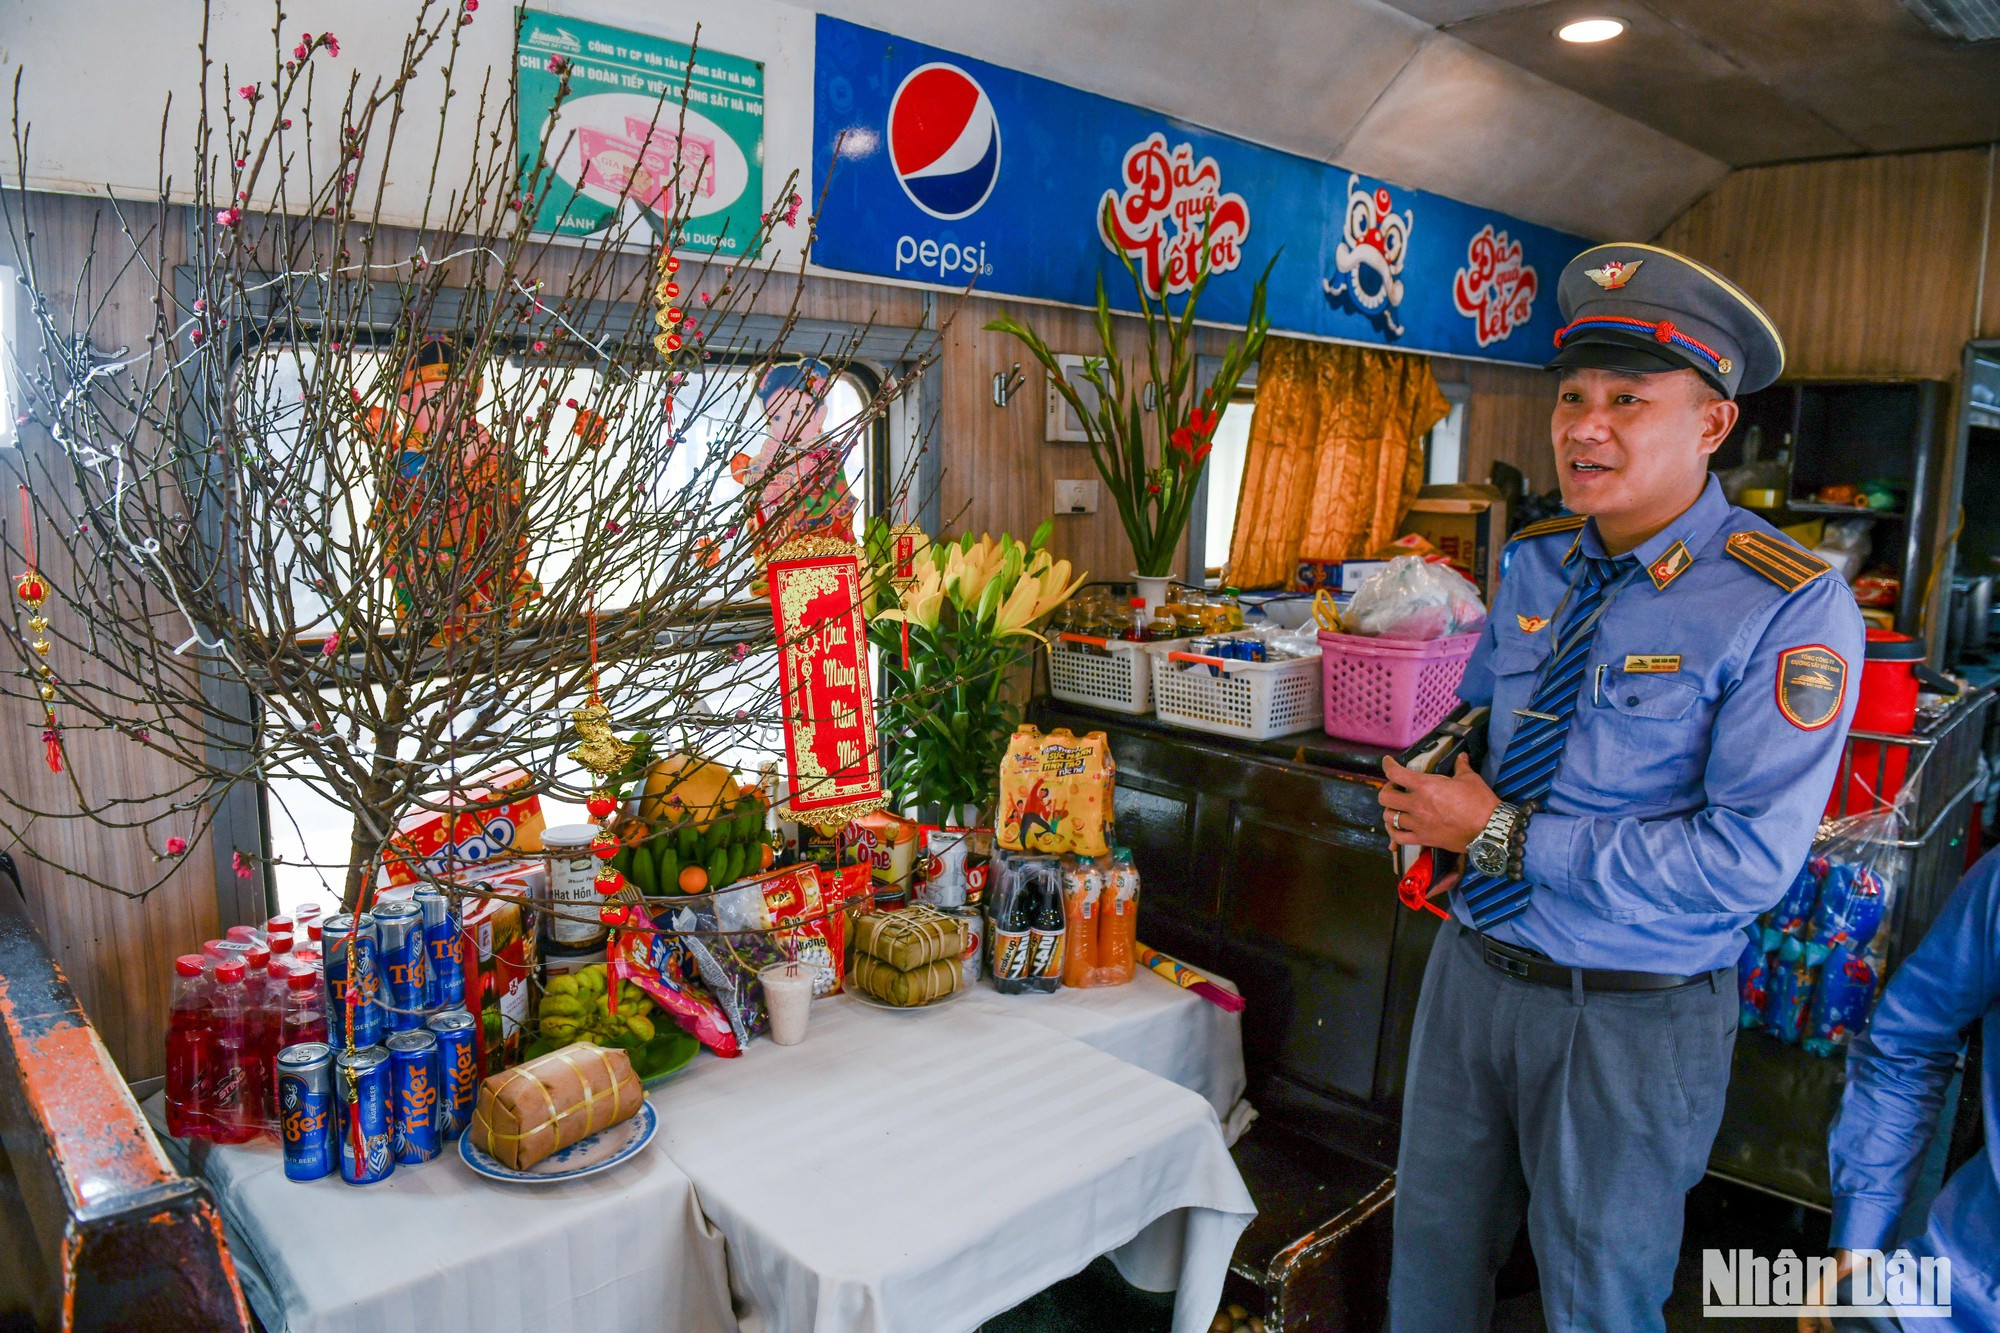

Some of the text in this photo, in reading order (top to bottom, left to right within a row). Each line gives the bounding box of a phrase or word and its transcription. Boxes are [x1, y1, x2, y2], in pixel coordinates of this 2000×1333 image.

[588, 40, 614, 55] CÔNG
[617, 47, 627, 58] TY
[629, 49, 642, 60] CP
[644, 53, 662, 66] VẬN
[664, 56, 678, 69] TẢI
[711, 67, 726, 80] SẮT
[728, 72, 739, 83] HÀ
[741, 75, 756, 88] NỘI
[520, 55, 540, 69] CHI
[587, 66, 619, 84] ĐOÀN
[621, 73, 644, 90] TIẾP
[647, 79, 671, 95] VIÊN
[710, 92, 729, 108] SẮT
[731, 97, 745, 111] HÀ
[746, 101, 763, 117] NỘI
[1125, 140, 1216, 224] Đã
[1175, 186, 1217, 233] quá
[896, 235, 986, 278] pepsi
[1210, 236, 1237, 267] ơi
[1471, 229, 1521, 291] Đã
[823, 616, 848, 654] Chúc
[823, 658, 856, 693] Mừng
[831, 700, 857, 729] Năm
[837, 738, 860, 769] Mới
[857, 842, 891, 869] One
[219, 1070, 246, 1100] STING
[449, 1043, 478, 1110] Tiger
[369, 1085, 377, 1124] LAGER BEER
[401, 1064, 437, 1134] Tiger
[281, 1110, 327, 1142] iger
[298, 1156, 317, 1164] BEER
